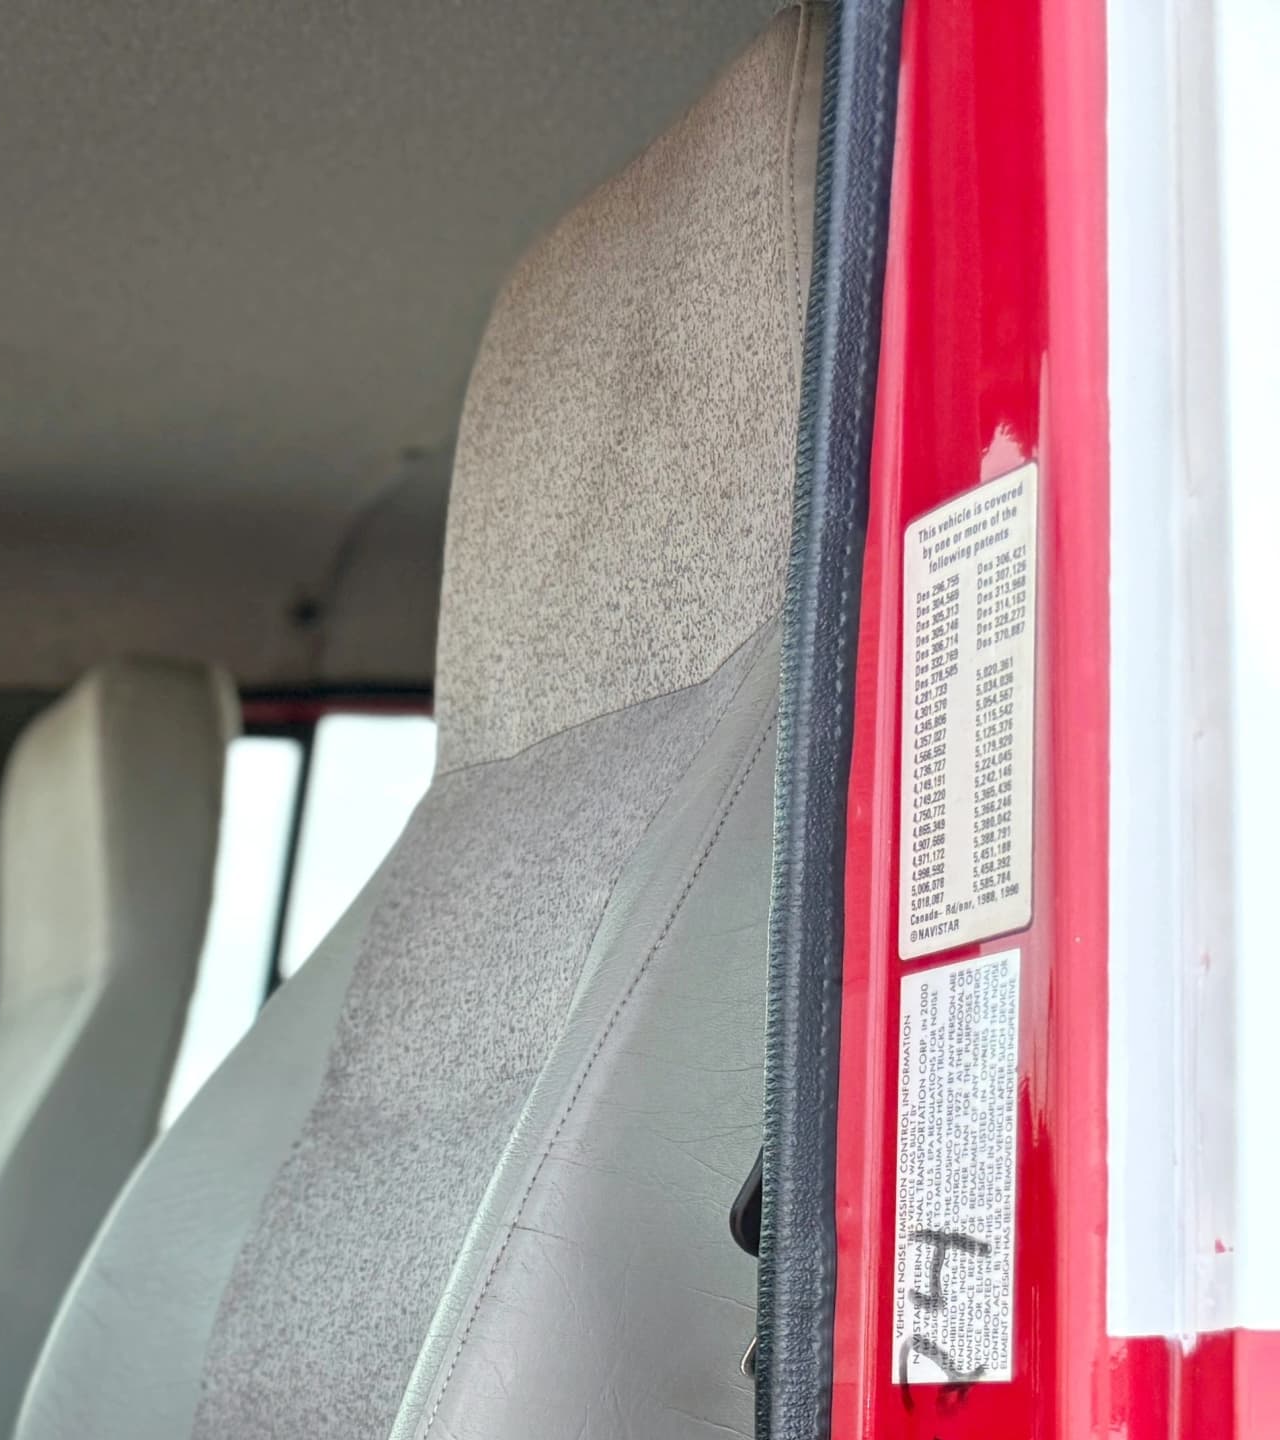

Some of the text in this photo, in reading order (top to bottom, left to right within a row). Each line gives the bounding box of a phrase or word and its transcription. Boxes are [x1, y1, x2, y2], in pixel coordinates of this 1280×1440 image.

[919, 525, 936, 544] This
[938, 508, 971, 533] vehicle
[984, 482, 1023, 512] covered
[923, 546, 931, 561] by
[934, 538, 950, 554] one
[964, 520, 987, 539] more
[990, 512, 999, 527] of
[1001, 505, 1016, 521] the
[929, 528, 1008, 576] following patents
[920, 983, 928, 1015] 2000
[910, 1104, 916, 1115] BY
[927, 1056, 935, 1136] REGULATIONS
[916, 1078, 926, 1191] TRANSPORTATION
[935, 1117, 943, 1144] AND
[896, 1014, 910, 1337] VEHICLE NOISE EMISSION CONTROL INFORMATION
[926, 1190, 933, 1205] TO
[934, 1147, 942, 1197] MEDIUM
[952, 1167, 960, 1223] CONTROL
[977, 1161, 985, 1206] DESIGN
[986, 1163, 994, 1209] VEHICLE
[934, 1201, 941, 1216] TO
[914, 1197, 923, 1298] INTERNATIONAL
[966, 1129, 977, 1370] MAINTENANCE REPLACEMENT
[1001, 1253, 1010, 1296] DESIGN
[912, 1303, 921, 1364] NAVISTAR
[991, 1312, 1000, 1369] CONTROL
